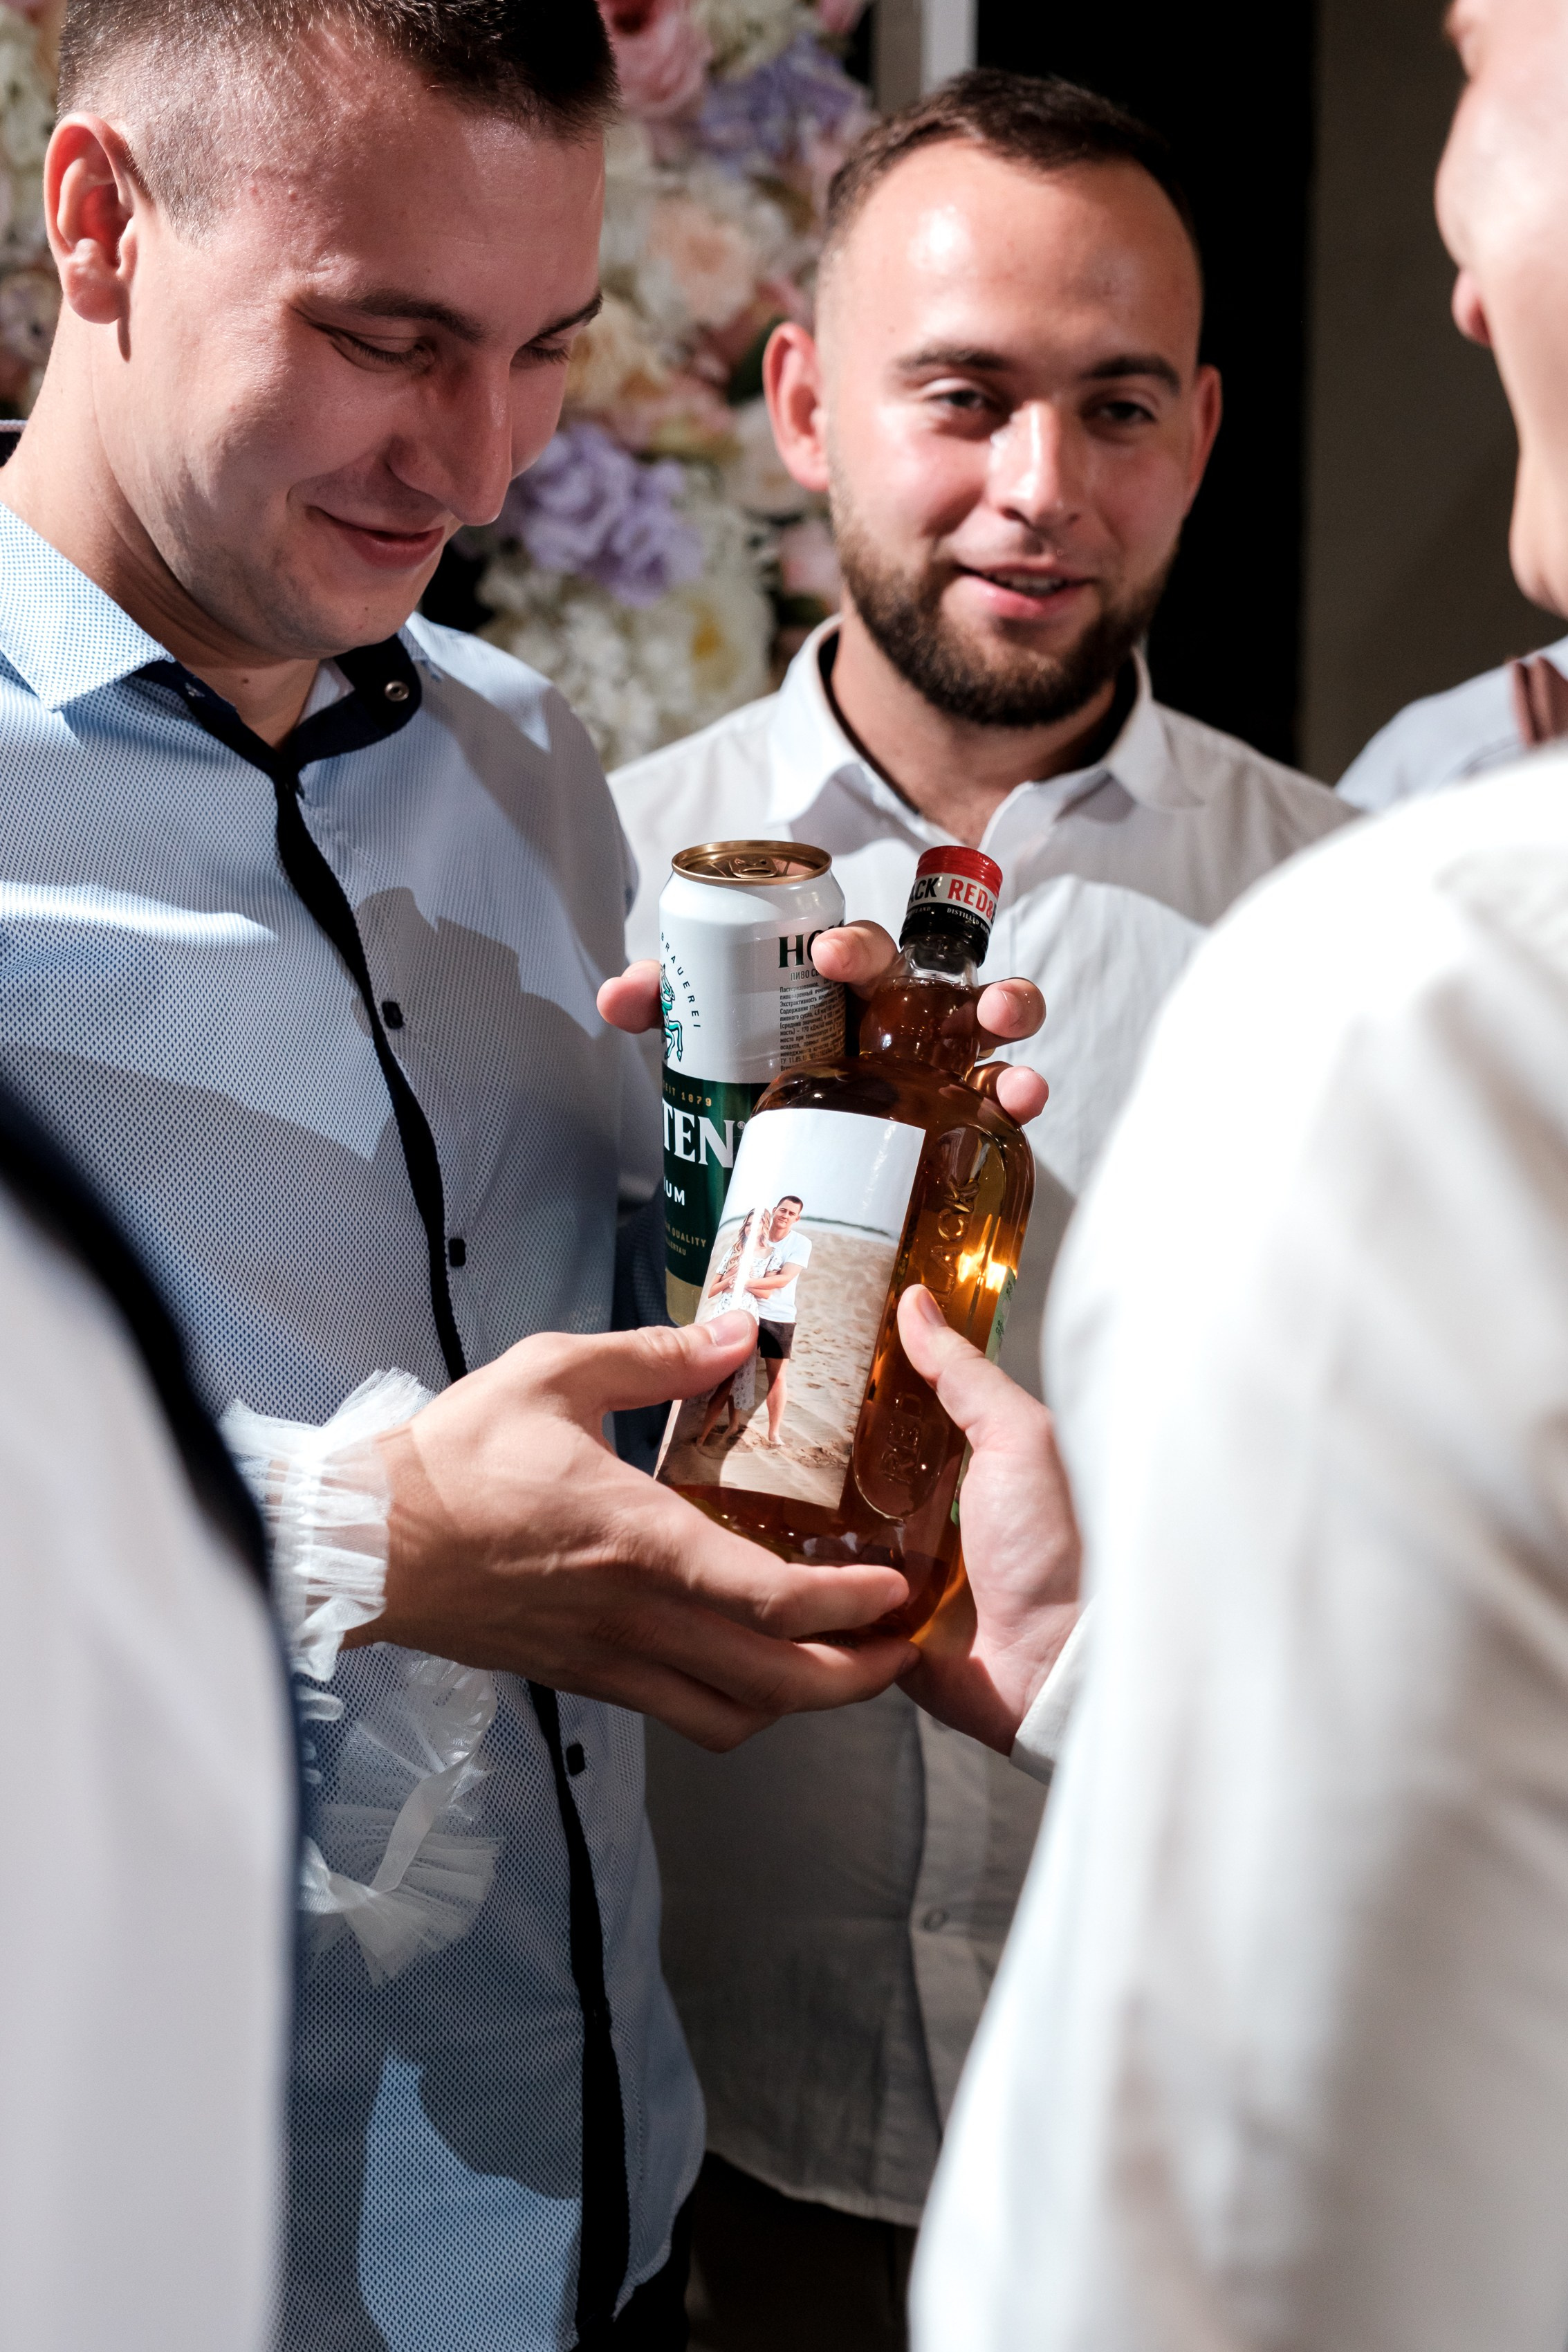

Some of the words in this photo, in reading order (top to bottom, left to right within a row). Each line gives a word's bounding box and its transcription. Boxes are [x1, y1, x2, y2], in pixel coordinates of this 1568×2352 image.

[661, 932, 701, 1027] BRAUEREI
[791, 970, 809, 980] ПИВО
[780, 1005, 809, 1015] Содержание
[663, 1080, 675, 1096] EIT
[681, 1092, 712, 1106] 1879
[672, 1227, 706, 1248] QUALITY
